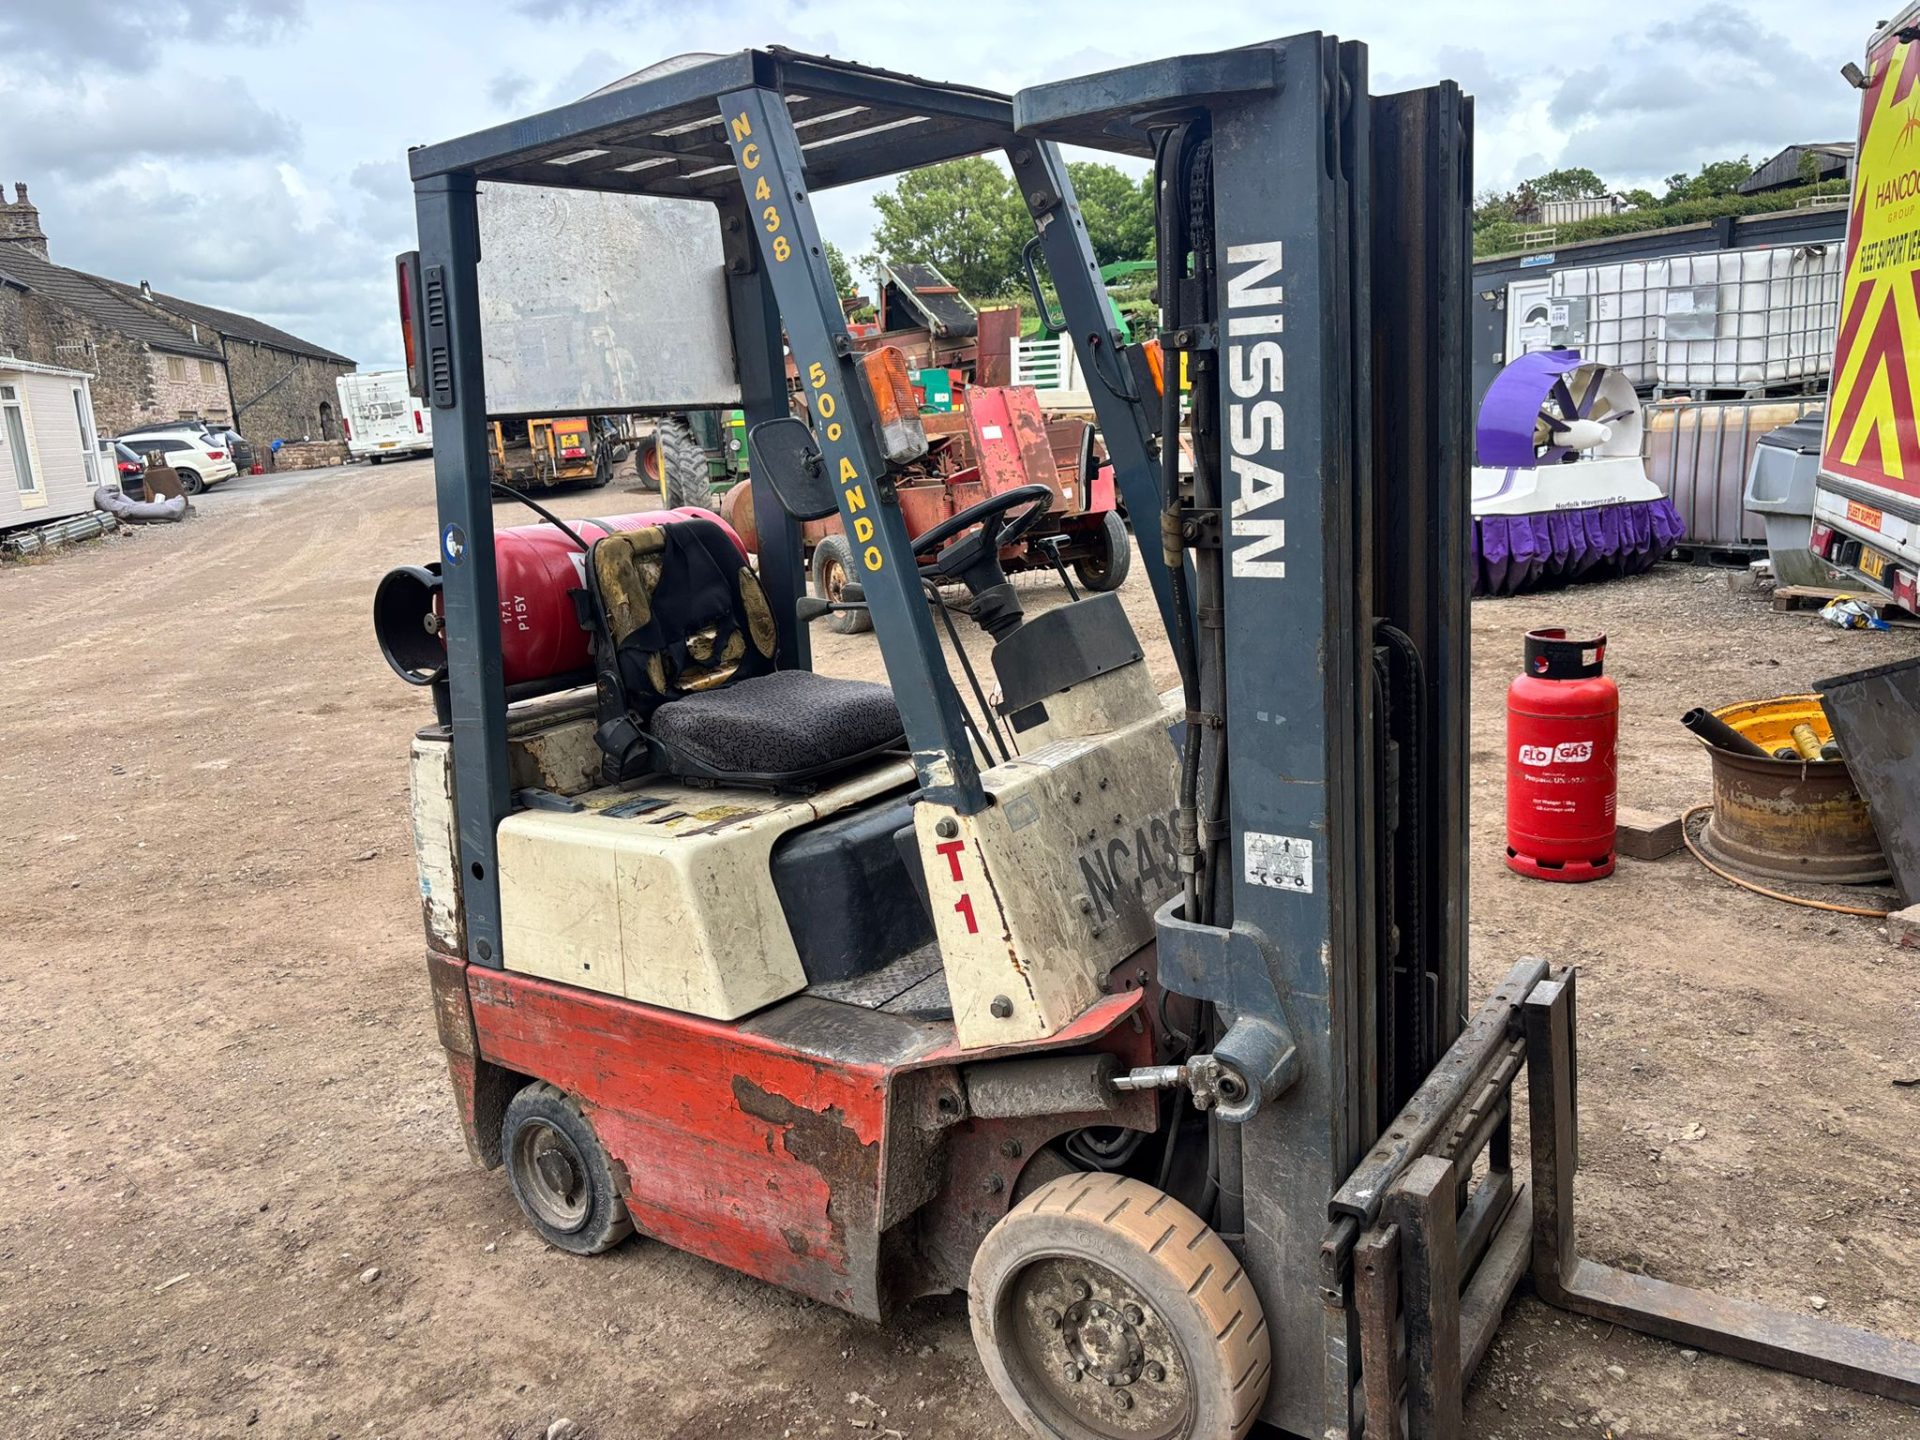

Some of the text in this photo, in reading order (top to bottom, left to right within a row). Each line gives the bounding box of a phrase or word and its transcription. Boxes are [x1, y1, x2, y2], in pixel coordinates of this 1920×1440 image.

[731, 111, 791, 263] NC438
[1887, 204, 1915, 223] GROUP
[1859, 242, 1878, 274] FLEET
[1877, 232, 1908, 269] SUPPORT
[1226, 240, 1286, 579] NISSAN
[839, 456, 883, 571] ANDO
[1555, 501, 1580, 509] Norfolk
[1581, 496, 1616, 506] Hovercraft
[501, 601, 512, 624] 17.1
[514, 595, 530, 631] P15Y
